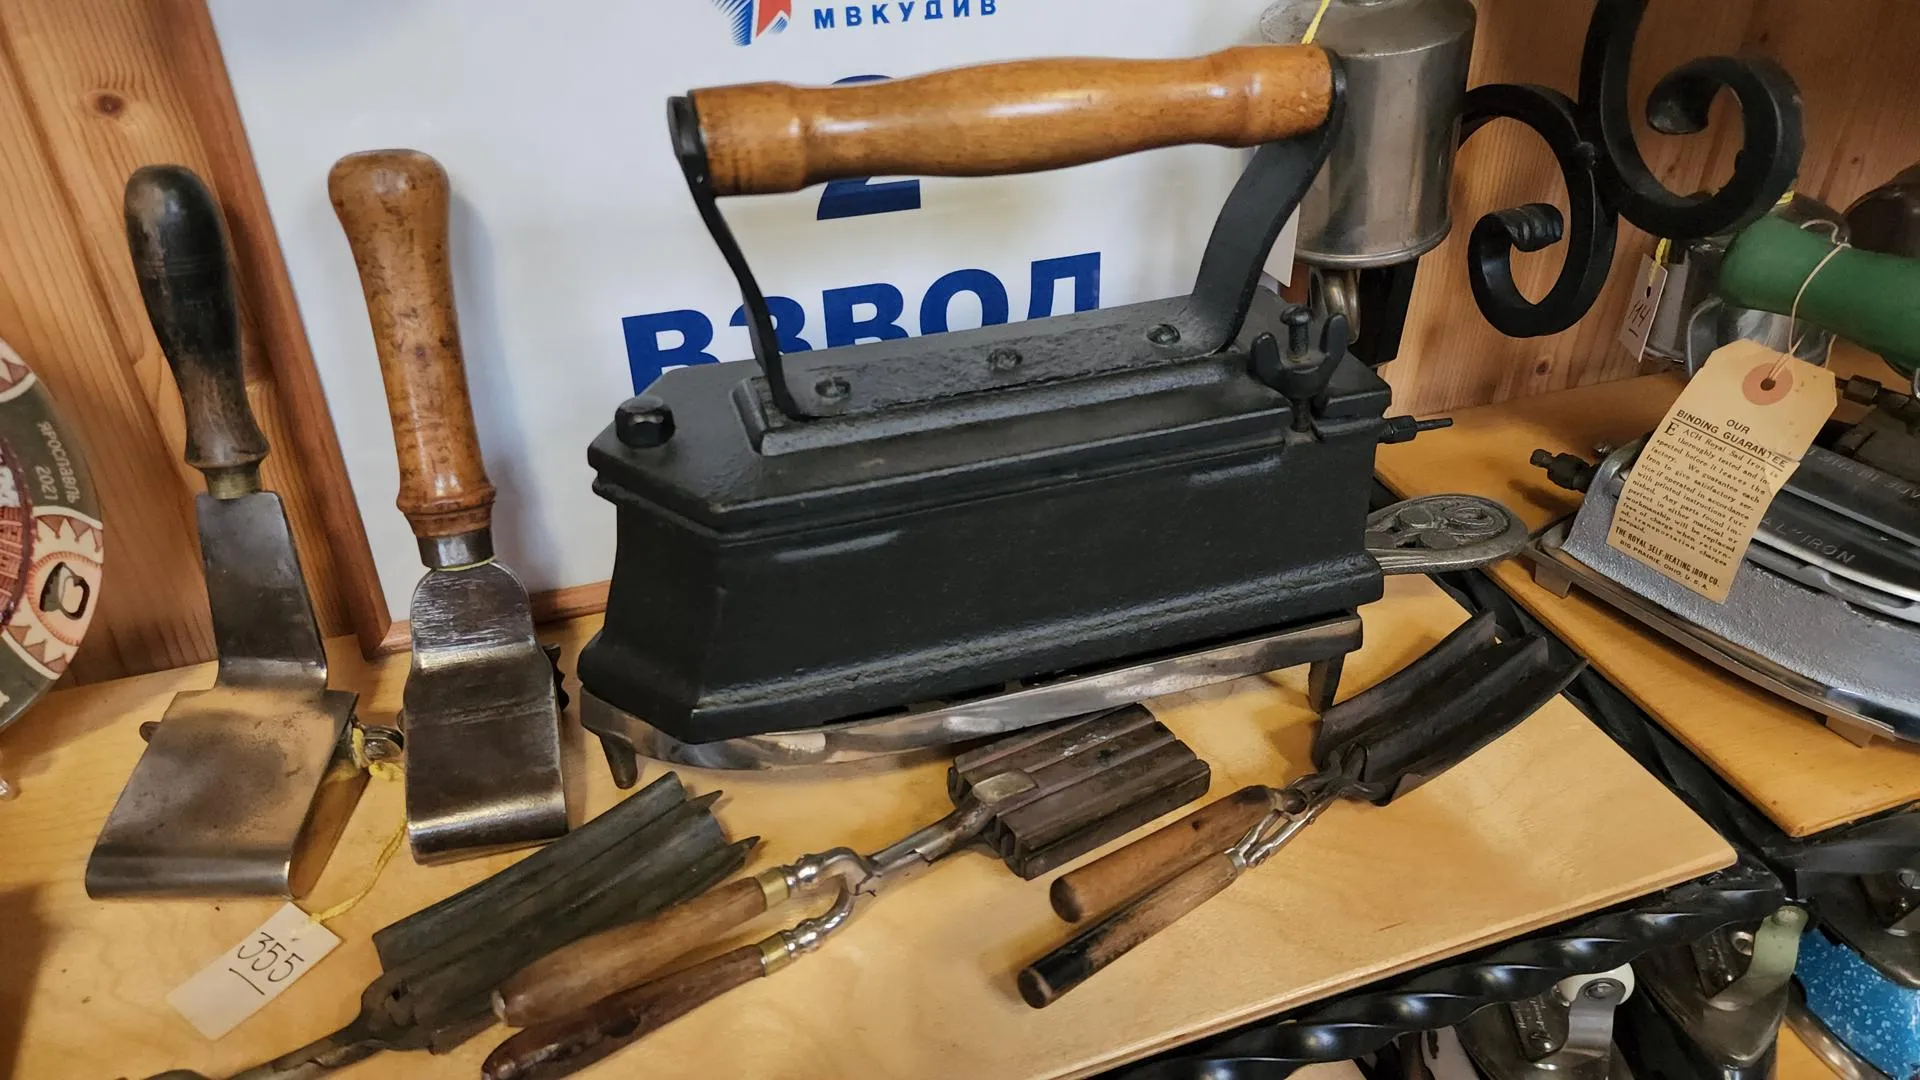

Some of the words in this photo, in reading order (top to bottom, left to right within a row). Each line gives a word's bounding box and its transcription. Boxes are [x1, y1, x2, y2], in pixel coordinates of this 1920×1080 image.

[813, 0, 997, 29] МВКУДИВ
[1676, 408, 1720, 435] BINDING
[1722, 431, 1790, 469] GUARANTEE
[1725, 418, 1751, 435] OUR
[1656, 439, 1684, 455] spected
[1684, 450, 1709, 467] before
[1718, 467, 1748, 486] leaves
[1750, 483, 1768, 496] the
[1677, 436, 1716, 460] thoroughly
[1717, 456, 1742, 472] tested
[1703, 437, 1727, 453] Royal
[1728, 449, 1745, 462] Sad
[34, 464, 59, 500] 2021
[1637, 470, 1655, 484] with
[1653, 479, 1682, 497] printed
[1682, 493, 1727, 519] instructions
[1645, 453, 1661, 467] Iron
[1693, 479, 1737, 503] satisfactory
[1701, 472, 1739, 494] guarantee
[1741, 492, 1760, 504] each
[1627, 486, 1654, 504] perfect
[1667, 507, 1690, 521] either
[1691, 519, 1725, 538] material
[1662, 494, 1679, 506] Any
[1679, 503, 1700, 517] parts
[1701, 513, 1725, 529] found
[1663, 474, 1697, 495] operated
[1707, 496, 1750, 521] accordance
[1627, 532, 1649, 549] ROYAL
[1690, 566, 1709, 581] IRON
[1702, 532, 1736, 553] replaced
[1802, 532, 1857, 565] IRON
[237, 931, 305, 983] 355
